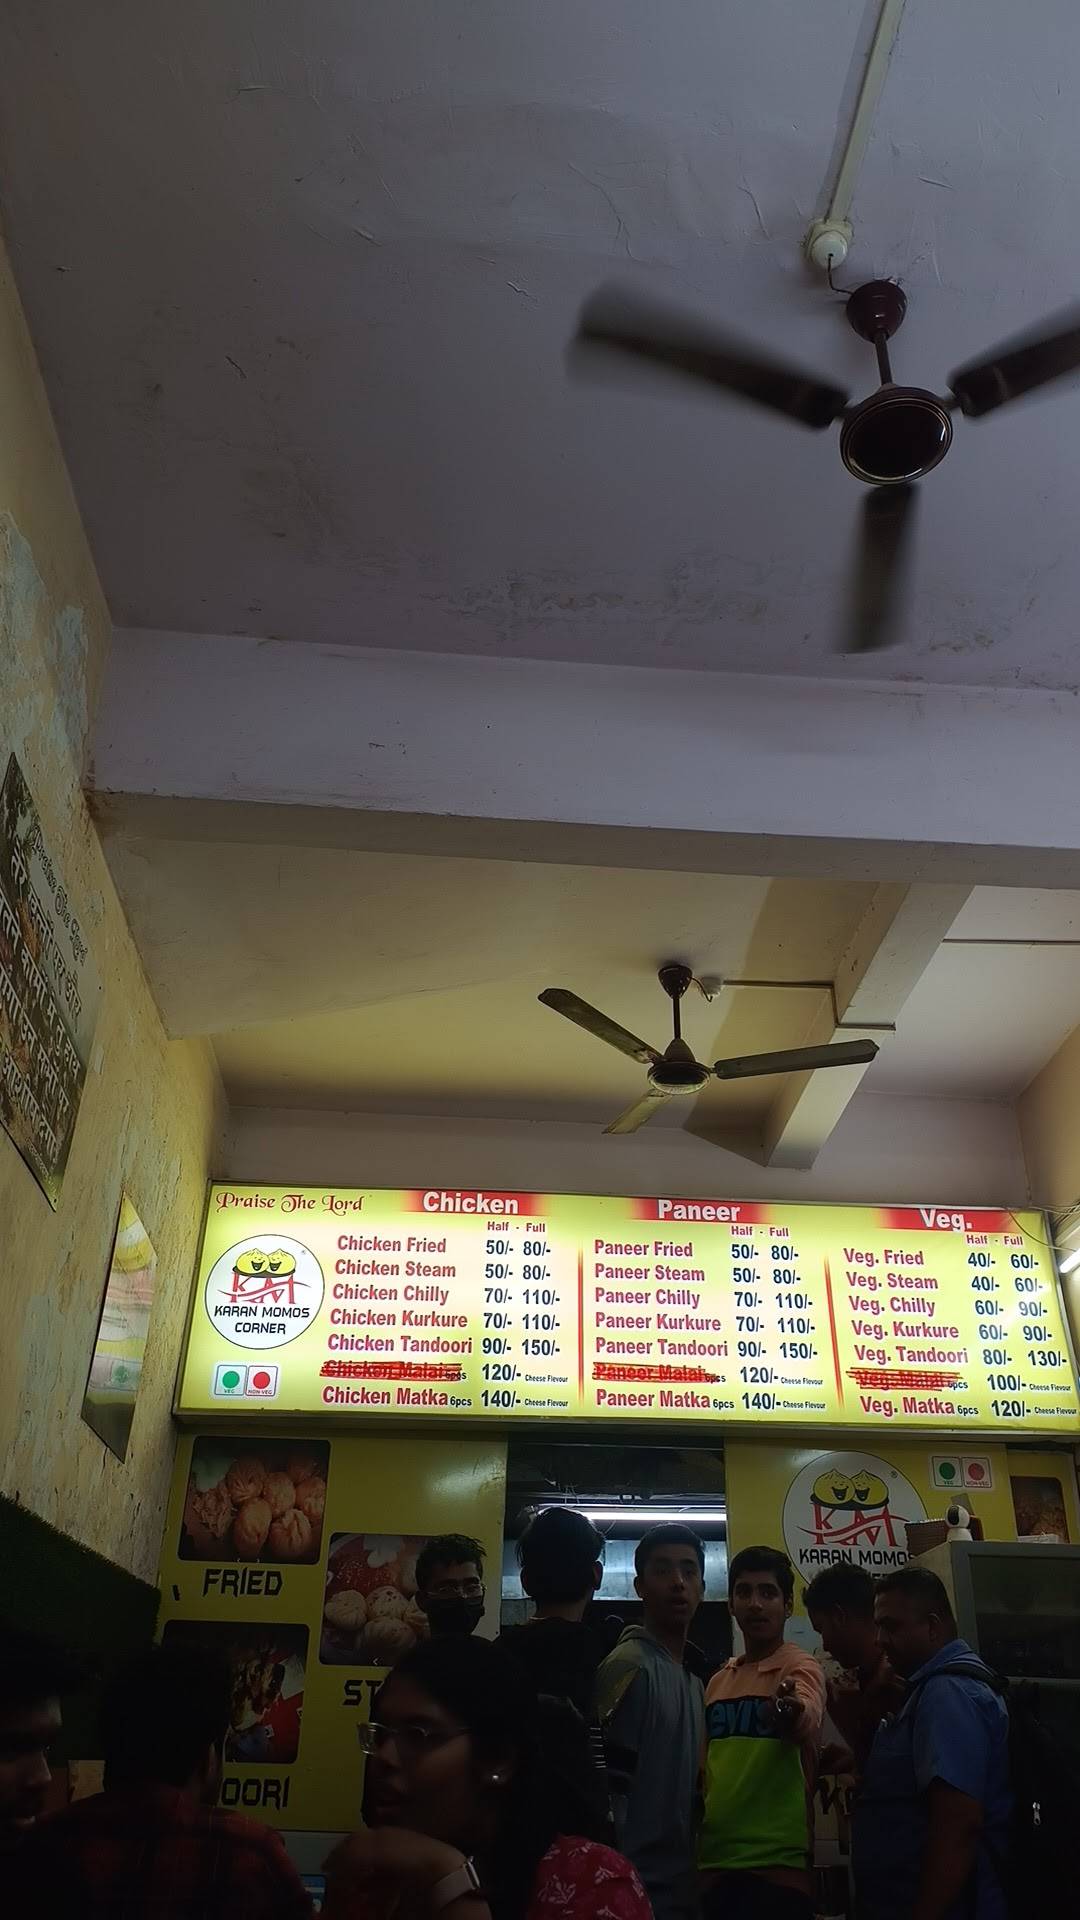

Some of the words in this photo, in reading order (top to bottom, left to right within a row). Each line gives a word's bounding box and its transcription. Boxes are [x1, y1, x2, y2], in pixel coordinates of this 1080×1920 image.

[216, 1192, 275, 1213] Praise
[281, 1195, 316, 1212] The
[322, 1195, 364, 1216] Lord
[423, 1191, 518, 1215] Chicken
[657, 1200, 740, 1221] Paneer
[487, 1221, 509, 1232] Half
[526, 1223, 546, 1233] Full
[920, 1208, 972, 1232] Veg.
[731, 1226, 753, 1236] Half
[769, 1228, 788, 1237] Full
[967, 1235, 988, 1244] Half
[1004, 1236, 1023, 1245] Full
[337, 1236, 401, 1252] Chicken
[406, 1238, 446, 1253] Fried
[486, 1240, 513, 1255] 50/-
[523, 1242, 551, 1256] 80/-
[594, 1240, 649, 1256] Paneer
[654, 1242, 693, 1257] Fried
[731, 1244, 759, 1259] 50/-
[771, 1246, 799, 1260] 80/-
[843, 1248, 878, 1267] Veg.
[884, 1250, 924, 1265] Fried
[968, 1253, 995, 1268] 40/-
[1011, 1254, 1039, 1269] 60/-
[335, 1259, 399, 1276] Chicken
[405, 1261, 456, 1277] Steam
[485, 1264, 513, 1279] 50/-
[522, 1265, 551, 1281] 80/-
[595, 1263, 650, 1279] Paneer
[655, 1265, 705, 1281] Steam
[733, 1268, 760, 1283] 50/-
[773, 1269, 801, 1284] 80/-
[846, 1272, 882, 1291] Veg.
[887, 1273, 938, 1289] Steam
[971, 1276, 1000, 1291] 40/-
[1015, 1278, 1043, 1293] 60/-
[332, 1284, 398, 1300] Chicken
[403, 1285, 449, 1305] Chilly
[484, 1288, 512, 1304] 70/-
[523, 1290, 560, 1305] 110/-
[595, 1287, 651, 1303] Paneer
[656, 1289, 700, 1309] Chilly
[734, 1292, 762, 1307] 70/-
[775, 1293, 812, 1309] 110/-
[215, 1306, 257, 1317] KARAN
[262, 1307, 310, 1318] MOMOS
[849, 1296, 884, 1315] Veg.
[890, 1297, 935, 1317] Chilly
[975, 1300, 1003, 1315] 60/-
[1019, 1302, 1047, 1317] 90/-
[235, 1322, 286, 1334] CORNER
[330, 1309, 396, 1326] Chicken
[402, 1311, 468, 1328] Kurkure
[483, 1313, 512, 1329] 70/-
[522, 1314, 560, 1331] 110/-
[596, 1312, 651, 1328] Paneer
[657, 1314, 721, 1330] Kurkure
[736, 1316, 764, 1332] 70/-
[777, 1318, 815, 1334] 110/-
[852, 1320, 888, 1340] Veg.
[893, 1322, 959, 1338] Kurkure
[979, 1325, 1008, 1340] 60/-
[1023, 1326, 1052, 1341] 90/-
[328, 1334, 394, 1351] Chicken
[401, 1336, 472, 1354] Tandoori
[482, 1337, 512, 1354] 90/-
[521, 1339, 560, 1356] 150/-
[596, 1337, 652, 1353] Paneer
[658, 1339, 728, 1356] Tandoori
[738, 1341, 766, 1357] 90/-
[779, 1343, 817, 1359] 150/-
[854, 1345, 891, 1365] Veg.
[896, 1346, 968, 1363] Tandoori
[983, 1349, 1012, 1365] 80/-
[1028, 1351, 1067, 1366] 130/-
[482, 1364, 521, 1381] 120/-
[740, 1367, 778, 1383] 120/-
[987, 1374, 1026, 1391] 100/-
[323, 1386, 390, 1404] Chicken
[397, 1388, 448, 1405] Matka
[450, 1396, 472, 1408] 6pcs
[482, 1390, 521, 1407] 140/-
[597, 1389, 654, 1407] Paneer
[660, 1391, 710, 1408] Matka
[713, 1399, 734, 1410] 6pcs
[742, 1393, 781, 1409] 140/-
[860, 1396, 898, 1417] Veg.
[902, 1397, 955, 1414] Matka
[958, 1406, 978, 1416] 6pcs
[992, 1400, 1031, 1417] 120/-
[800, 1549, 852, 1568] KARAN
[202, 1567, 283, 1597] FRIED
[218, 1776, 290, 1810] OORI
